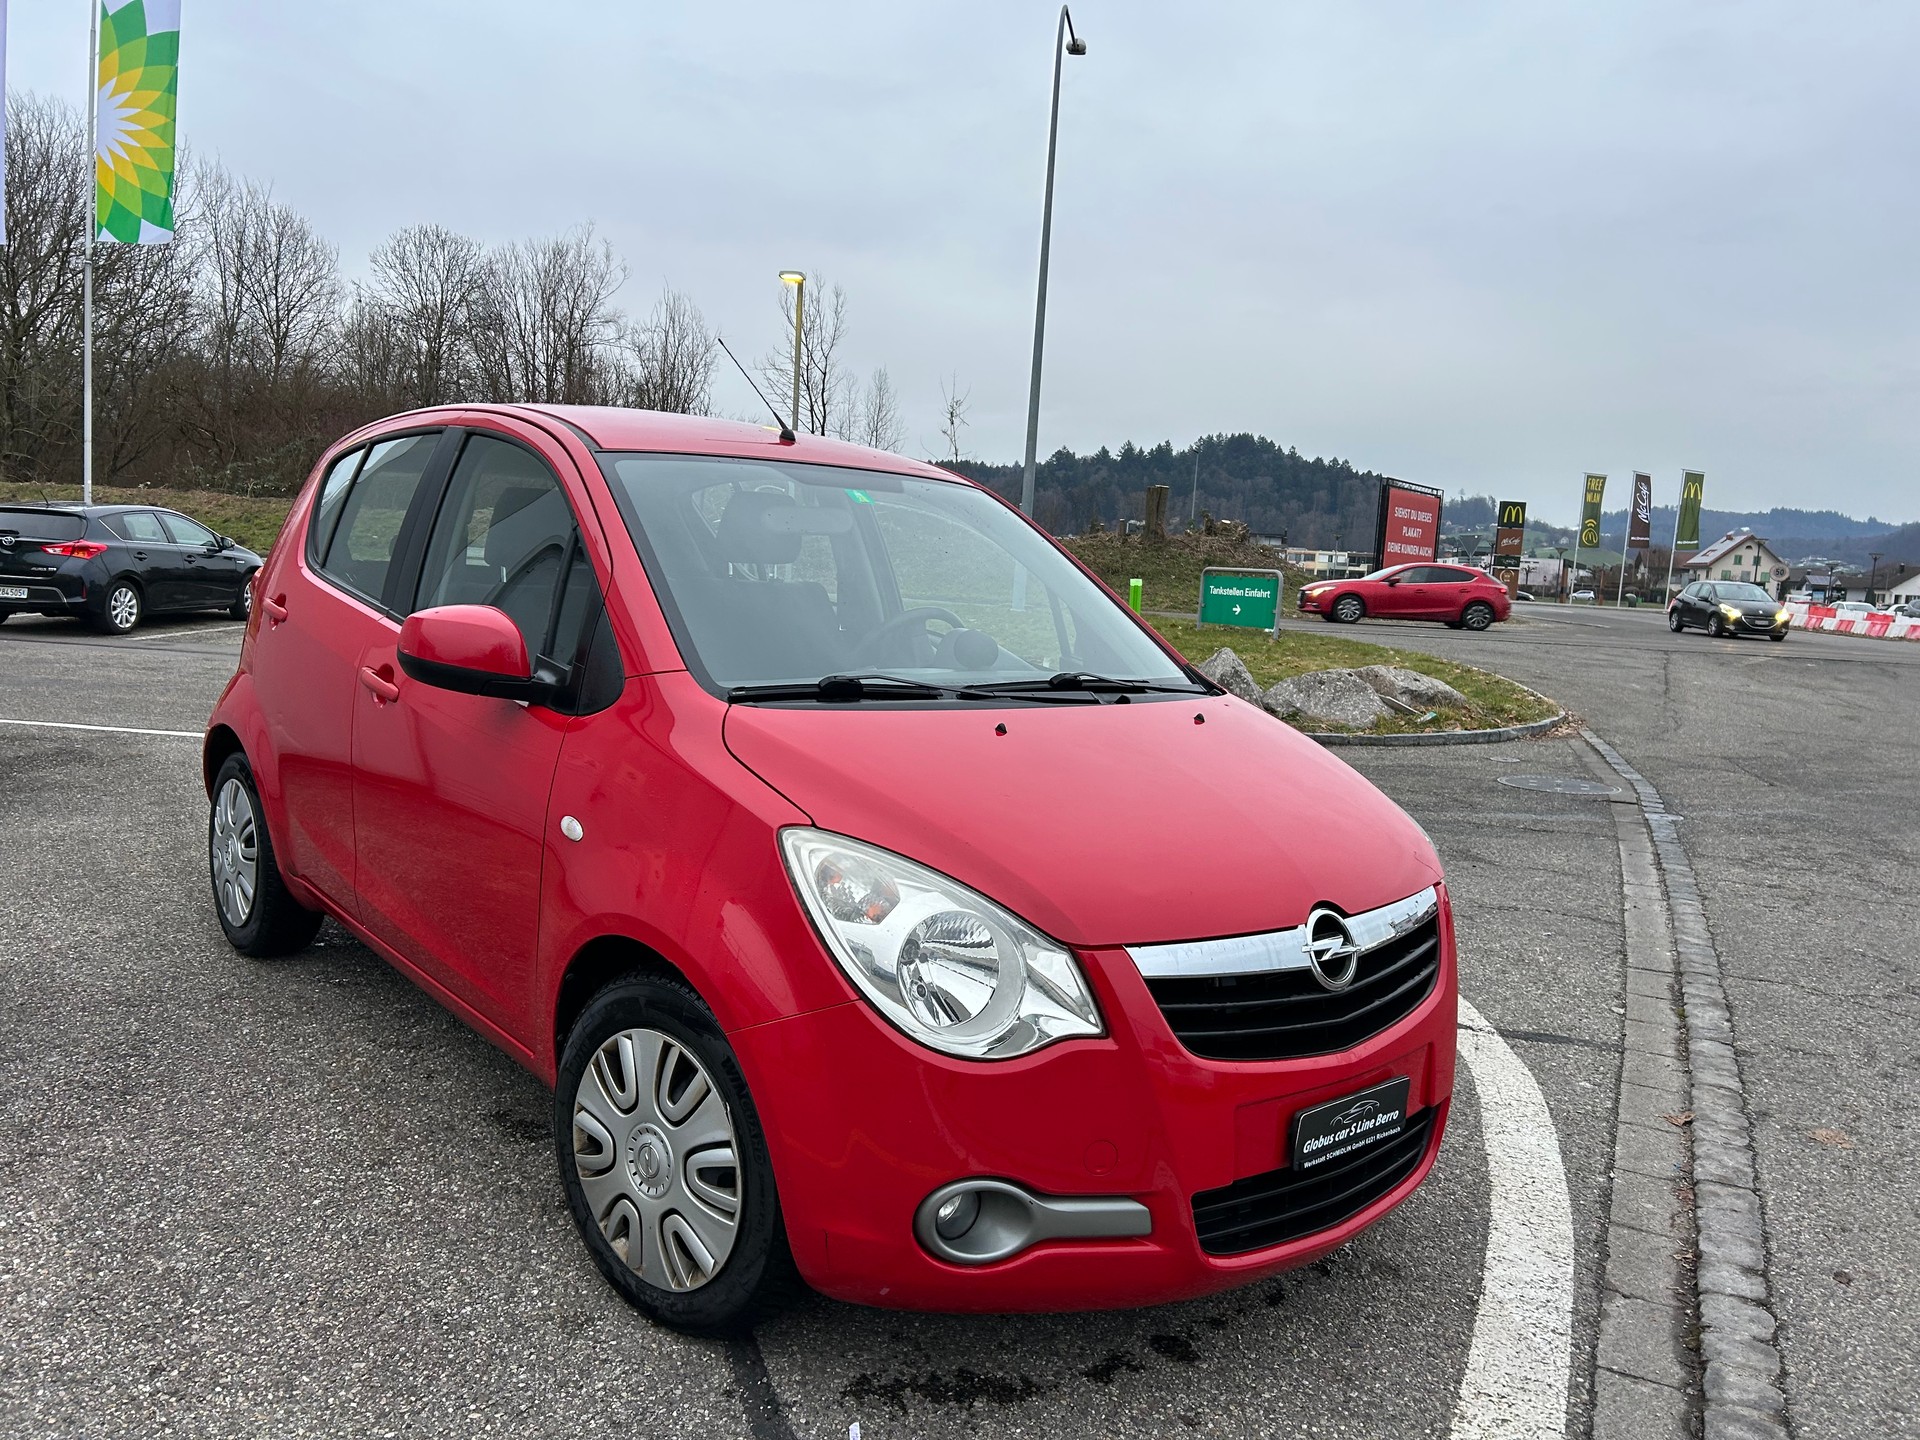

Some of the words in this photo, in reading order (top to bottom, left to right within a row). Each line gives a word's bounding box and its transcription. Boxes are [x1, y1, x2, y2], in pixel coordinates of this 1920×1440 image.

[1587, 477, 1604, 491] FREE
[1586, 491, 1600, 503] WLAN
[1394, 506, 1410, 519] SIEHST
[1410, 509, 1418, 520] DU
[1402, 526, 1422, 538] PLAKAT?
[1401, 544, 1419, 556] KUNDEN
[1775, 568, 1785, 576] 50
[1209, 585, 1244, 597] Tankstellen
[1244, 587, 1271, 598] Einfahrt
[1303, 1133, 1335, 1154] Globus
[1335, 1128, 1350, 1141] car
[1349, 1122, 1357, 1136] S
[1356, 1119, 1375, 1133] Line
[1375, 1110, 1399, 1126] Berro
[1304, 1155, 1326, 1168] Werkstatt
[1326, 1145, 1352, 1160] SCHMIDLIN
[1352, 1139, 1366, 1150] GmbH
[1376, 1126, 1401, 1140] Rickenbach
